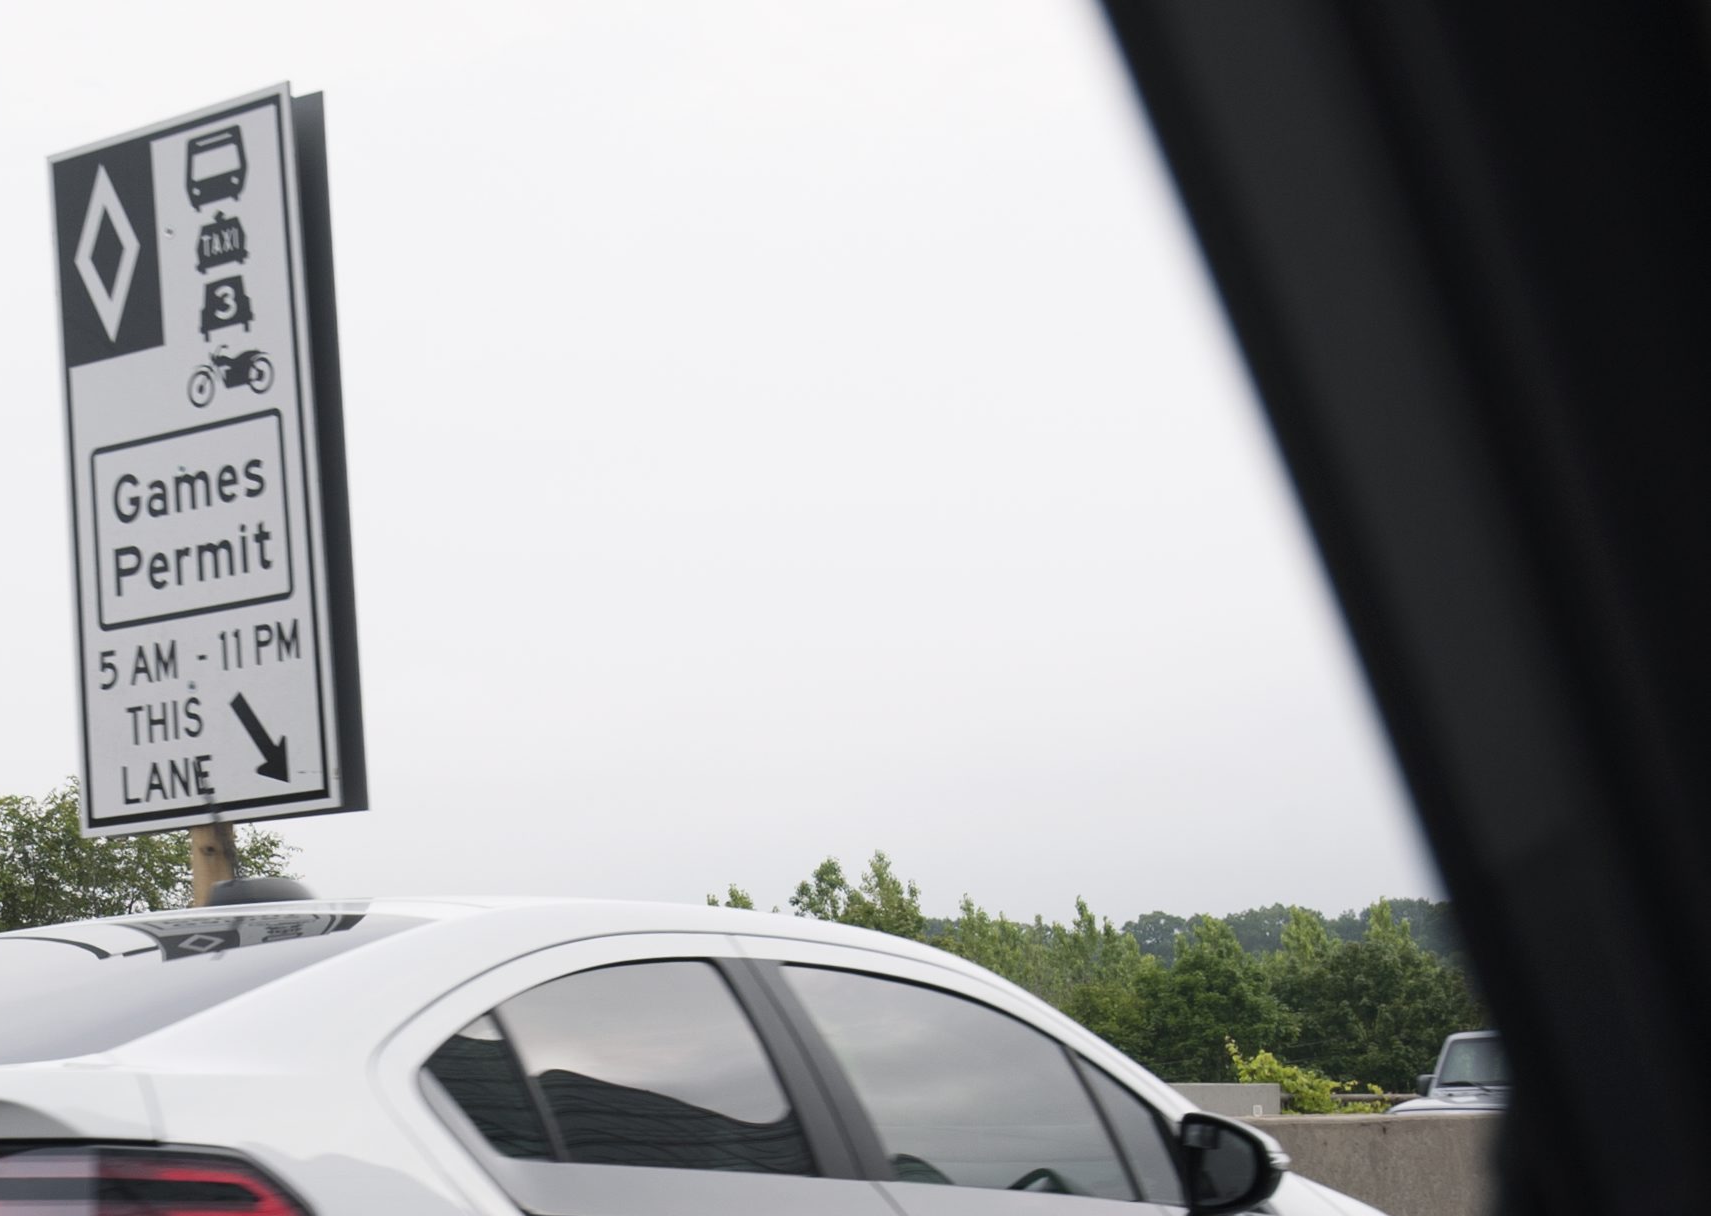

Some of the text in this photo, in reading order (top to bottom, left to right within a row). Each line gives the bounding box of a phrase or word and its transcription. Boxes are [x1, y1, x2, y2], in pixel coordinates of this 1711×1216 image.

[201, 227, 240, 257] TAXI
[214, 285, 237, 320] 3
[113, 458, 265, 523] Games
[113, 522, 272, 597] Permit
[99, 650, 119, 690] 5
[130, 639, 179, 686] AM
[218, 629, 243, 671] 11
[254, 618, 302, 666] PM
[126, 698, 203, 746] THIS
[121, 755, 215, 804] LANE
